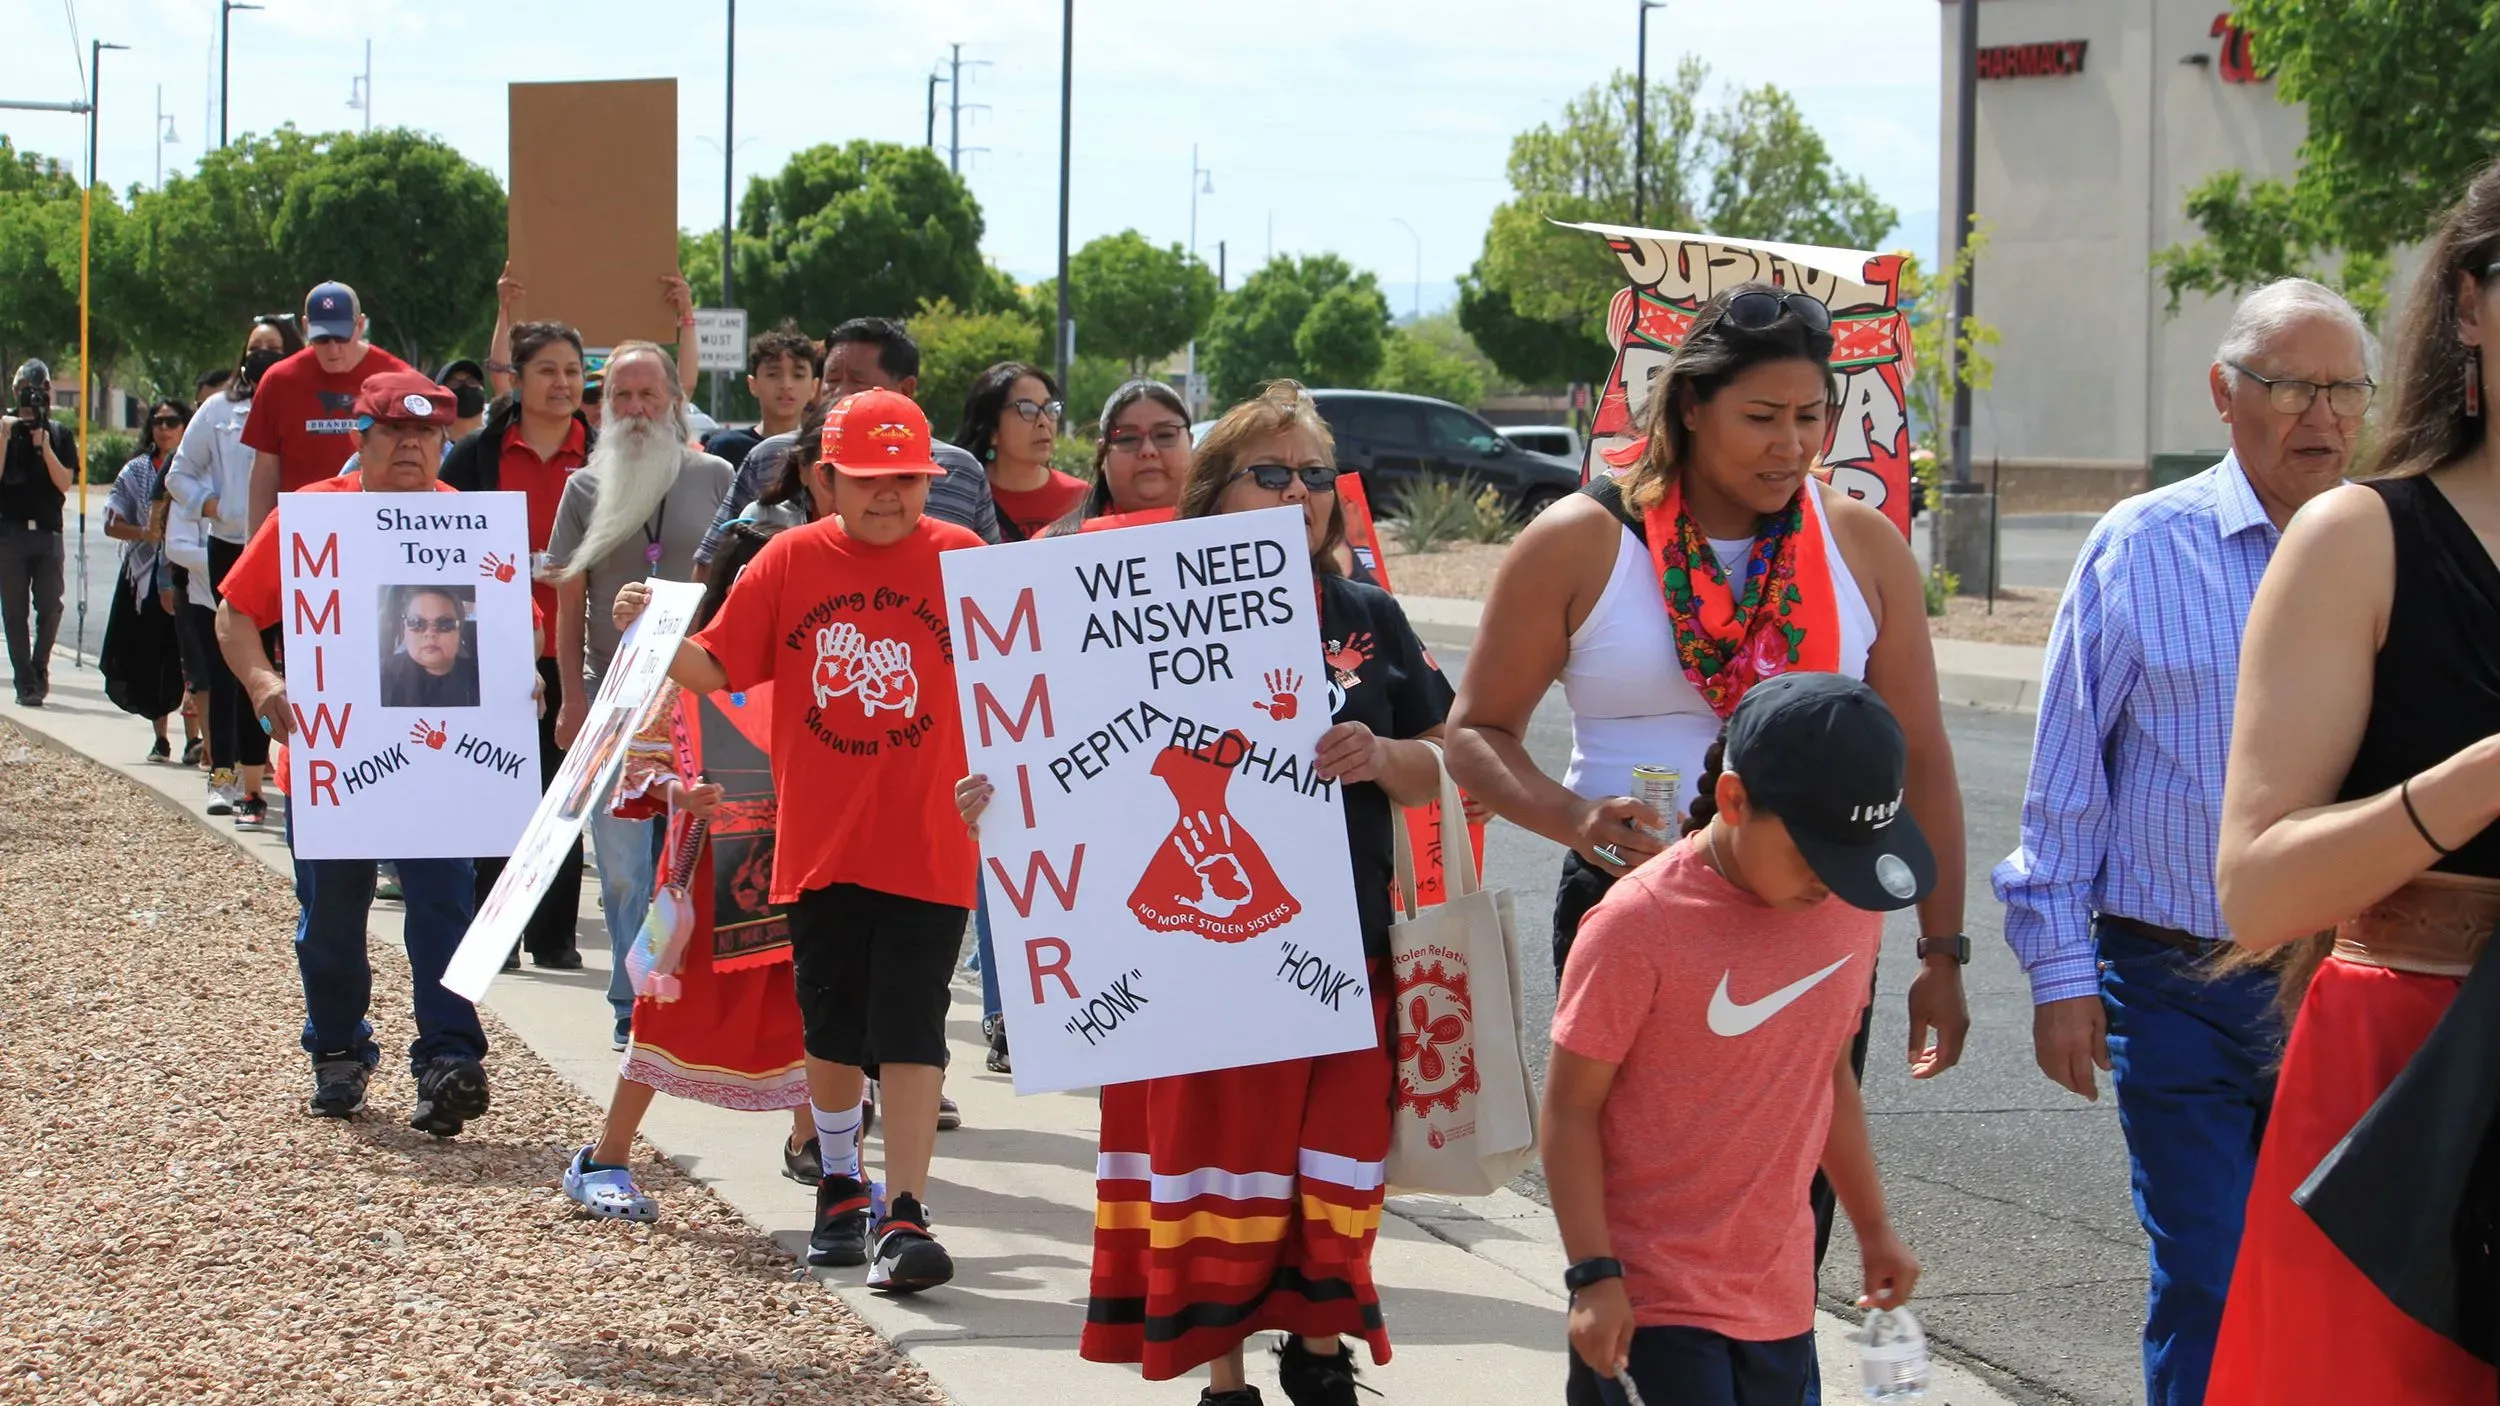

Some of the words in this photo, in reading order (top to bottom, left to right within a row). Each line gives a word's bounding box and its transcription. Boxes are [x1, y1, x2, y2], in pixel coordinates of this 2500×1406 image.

[1977, 39, 2088, 80] HARMACY
[696, 317, 715, 327] IGHT
[719, 317, 742, 328] LANE
[701, 334, 732, 346] MUST
[376, 507, 489, 531] Shawna
[399, 541, 467, 571] Toya
[1075, 556, 1152, 603] WE
[1176, 539, 1286, 590] NEED
[873, 586, 910, 612] for
[1080, 586, 1294, 654] ANSWERS
[1148, 642, 1234, 690] FOR
[804, 705, 880, 756] Shawna
[1048, 700, 1173, 794] PEPITA
[342, 742, 411, 795] HONK
[454, 733, 529, 780] HONK
[1138, 903, 1157, 920] NO
[1157, 913, 1195, 927] MORE
[1198, 918, 1244, 934] STOLEN
[1246, 902, 1290, 931] SISTERS
[1428, 944, 1468, 969] Relativ
